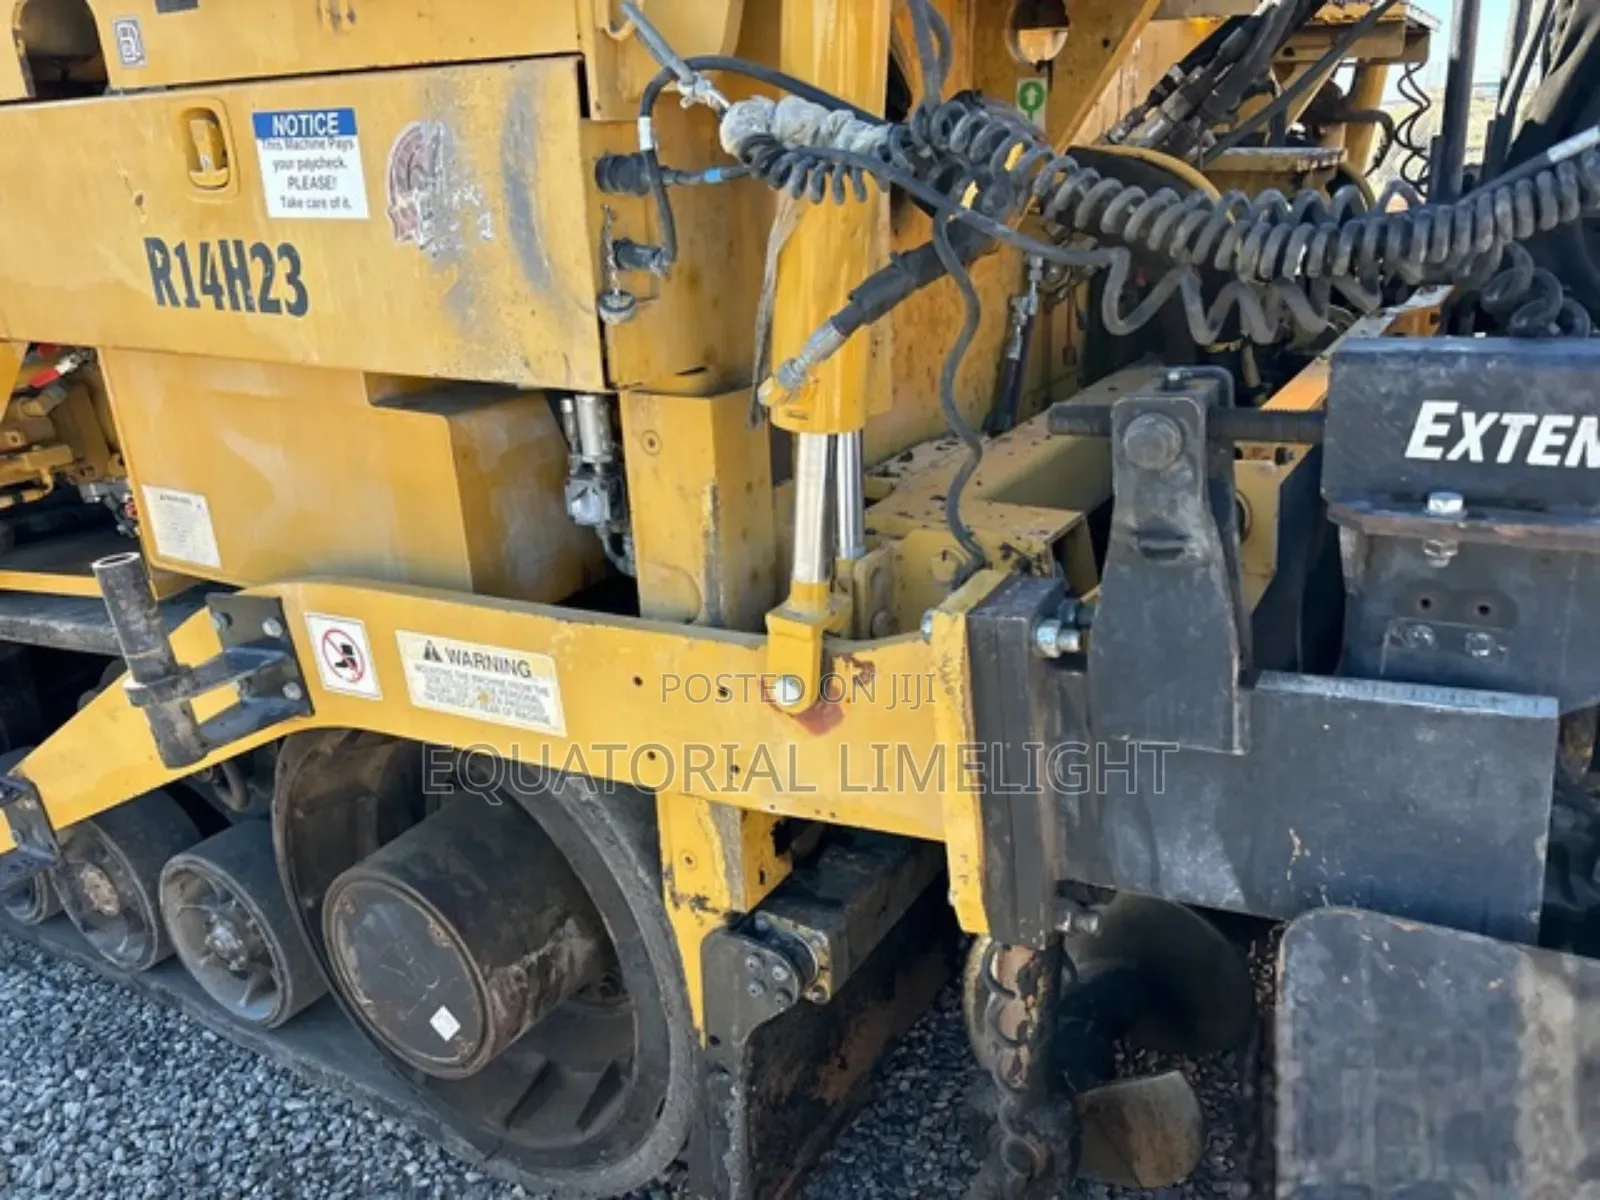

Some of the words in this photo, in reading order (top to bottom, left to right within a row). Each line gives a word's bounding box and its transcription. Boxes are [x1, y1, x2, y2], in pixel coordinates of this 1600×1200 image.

[272, 112, 340, 136] NOTICE
[285, 138, 326, 150] Machine
[272, 160, 294, 172] your
[287, 175, 337, 190] PLEASE!
[280, 195, 303, 208] Take
[306, 198, 327, 208] care
[330, 196, 341, 208] of
[144, 237, 308, 317] R14H23
[445, 647, 532, 678] WARNING
